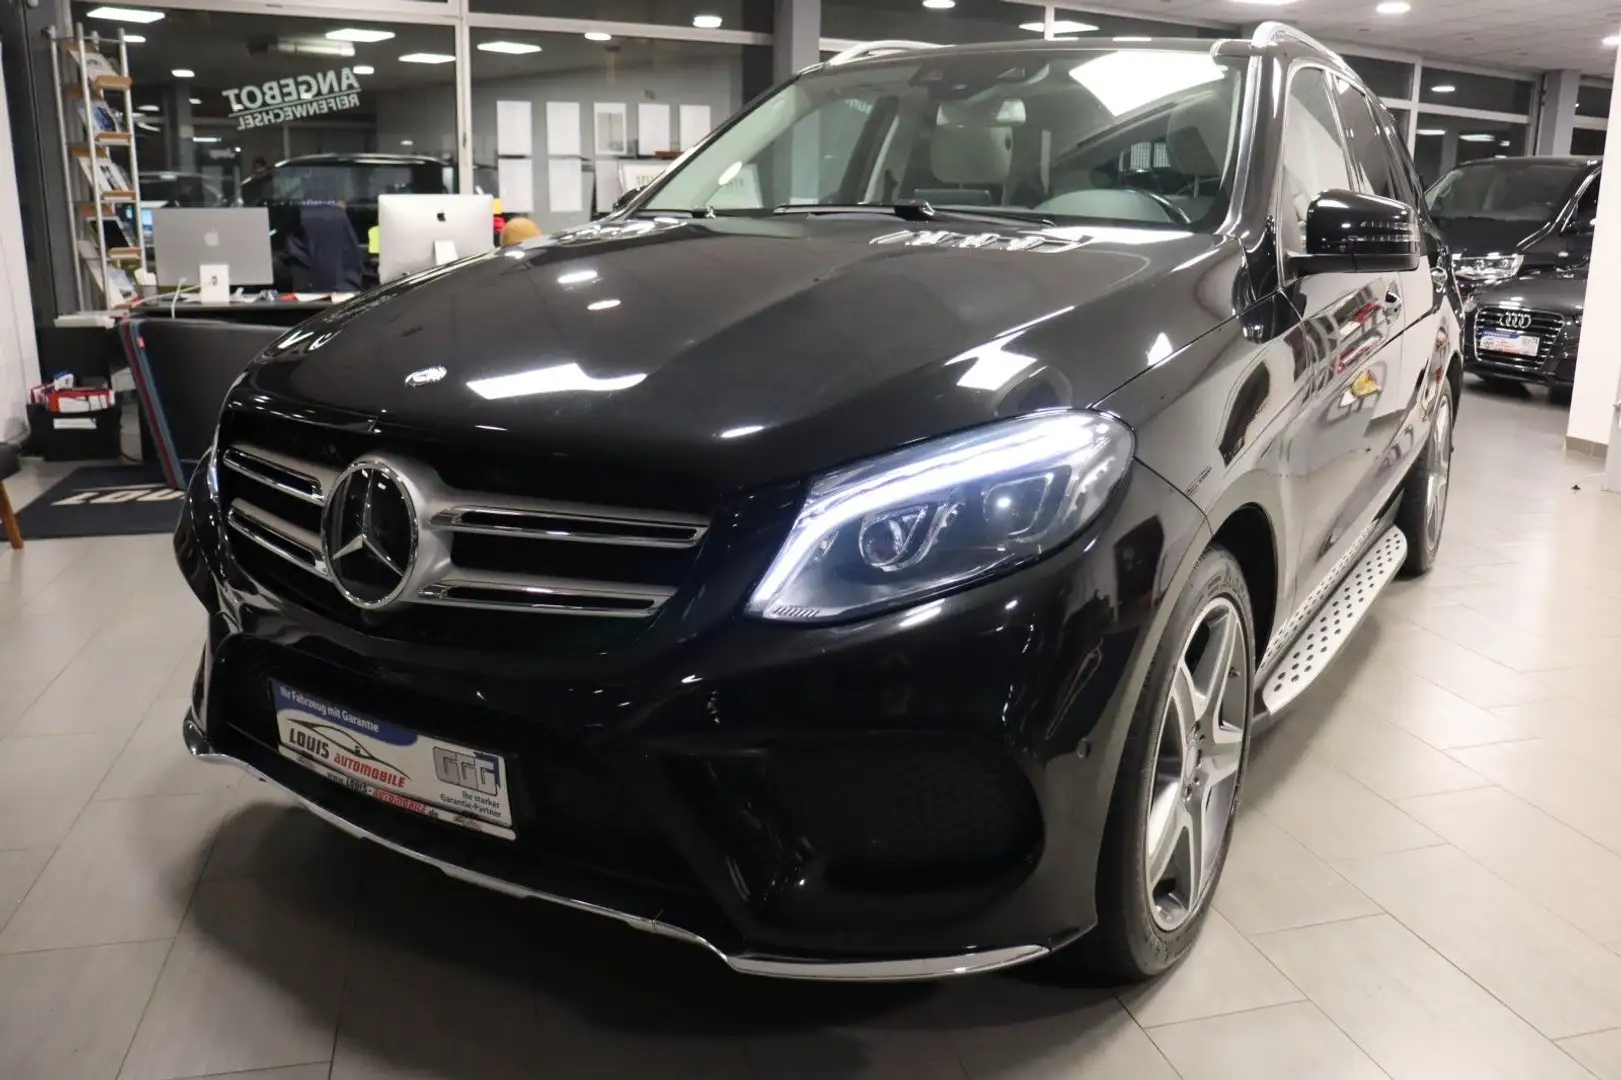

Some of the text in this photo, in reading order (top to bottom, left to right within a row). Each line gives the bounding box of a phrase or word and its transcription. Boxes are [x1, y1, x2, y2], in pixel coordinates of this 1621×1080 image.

[51, 487, 185, 506] LOU
[280, 686, 380, 733] Ihr Fahrzeug mit Garantie
[288, 727, 330, 760] LOUIS
[333, 752, 406, 788] AUTOMOBILE
[440, 793, 502, 818] Garantie-Partner
[474, 794, 500, 809] starker
